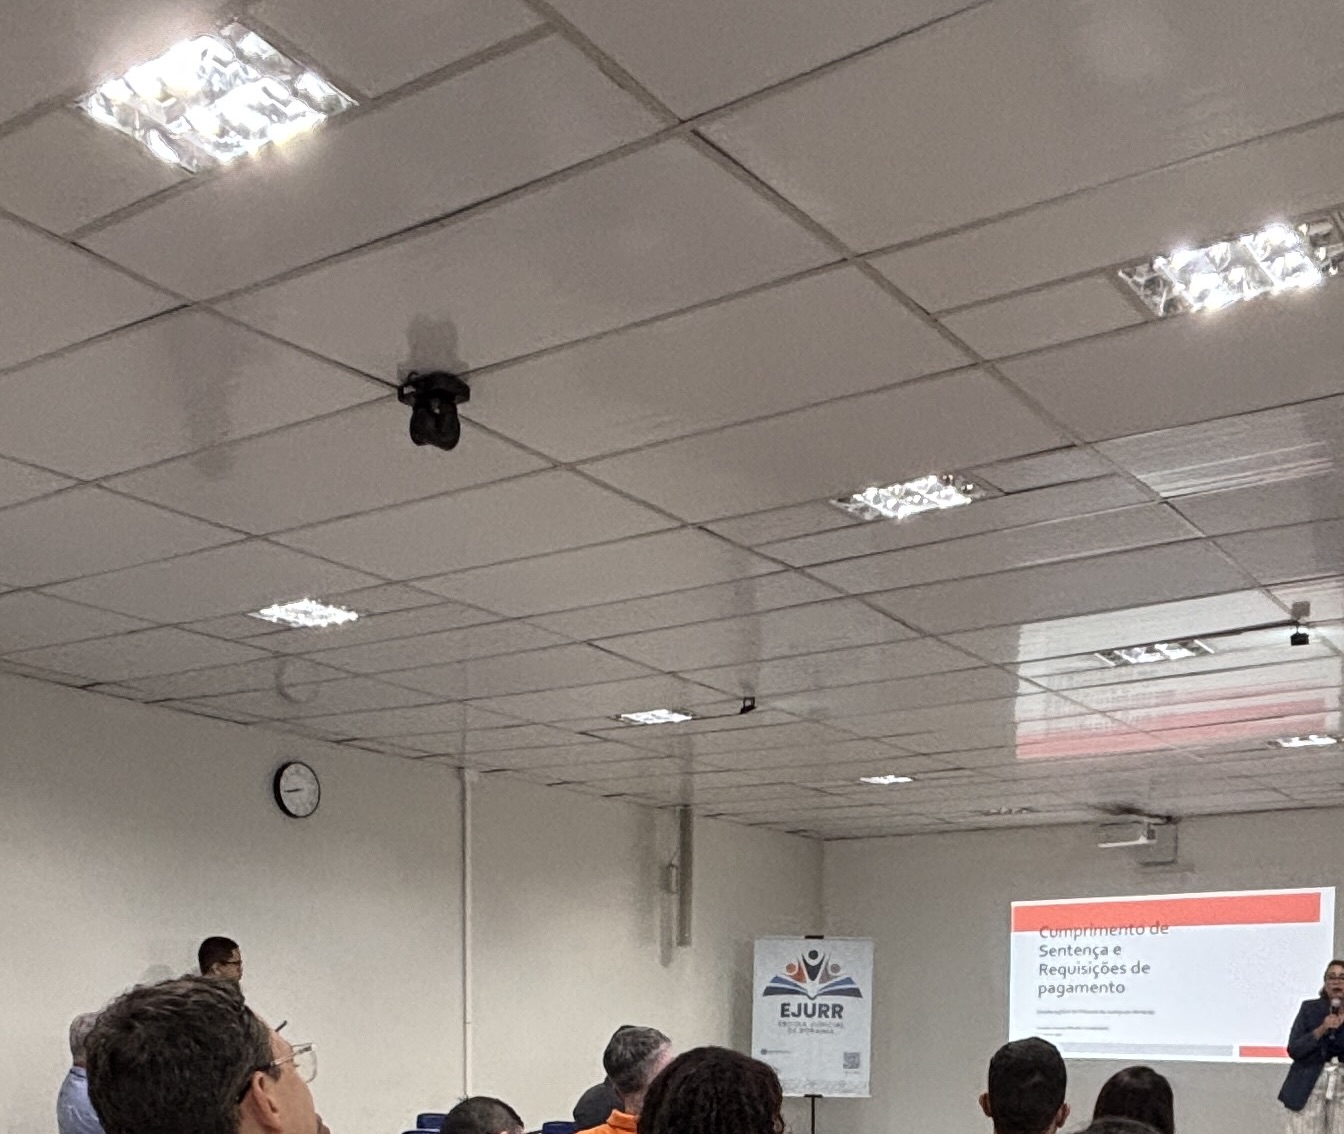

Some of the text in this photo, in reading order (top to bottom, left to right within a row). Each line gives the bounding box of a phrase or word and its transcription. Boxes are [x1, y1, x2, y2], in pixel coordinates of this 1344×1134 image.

[1039, 920, 1169, 940] Cumprimento de
[1038, 944, 1122, 960] Sentença e
[1038, 960, 1151, 979] Requisições de
[1038, 981, 1126, 999] pagamento
[780, 1002, 844, 1019] EJURR
